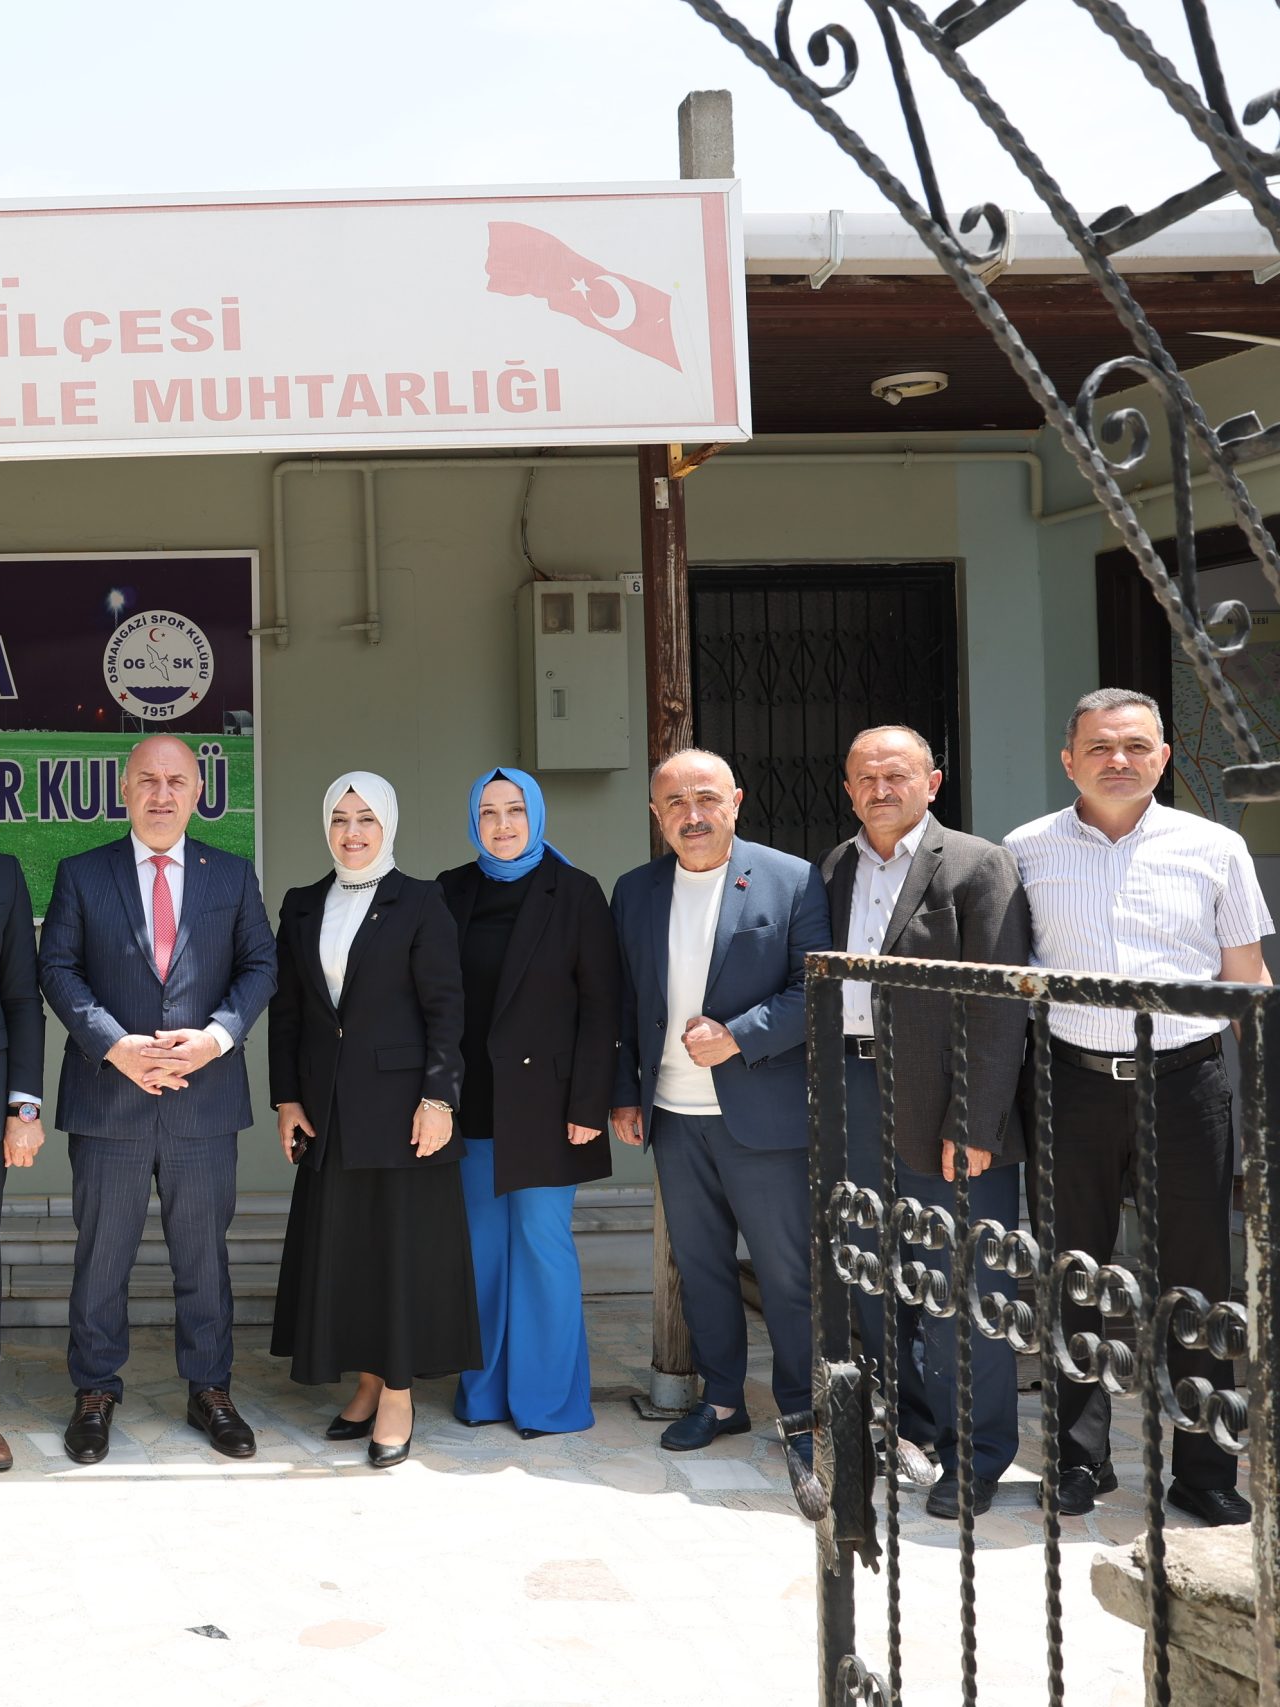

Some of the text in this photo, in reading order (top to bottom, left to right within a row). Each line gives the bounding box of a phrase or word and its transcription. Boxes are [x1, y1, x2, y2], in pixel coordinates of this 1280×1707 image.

[132, 359, 562, 424] MUHTARLIĞI
[633, 581, 641, 592] 6
[108, 614, 210, 683] OSMANGAZİ SPOR KULÜBÜ
[123, 658, 194, 669] OG SK
[142, 705, 175, 717] 1957
[37, 742, 229, 823] KULÜ
